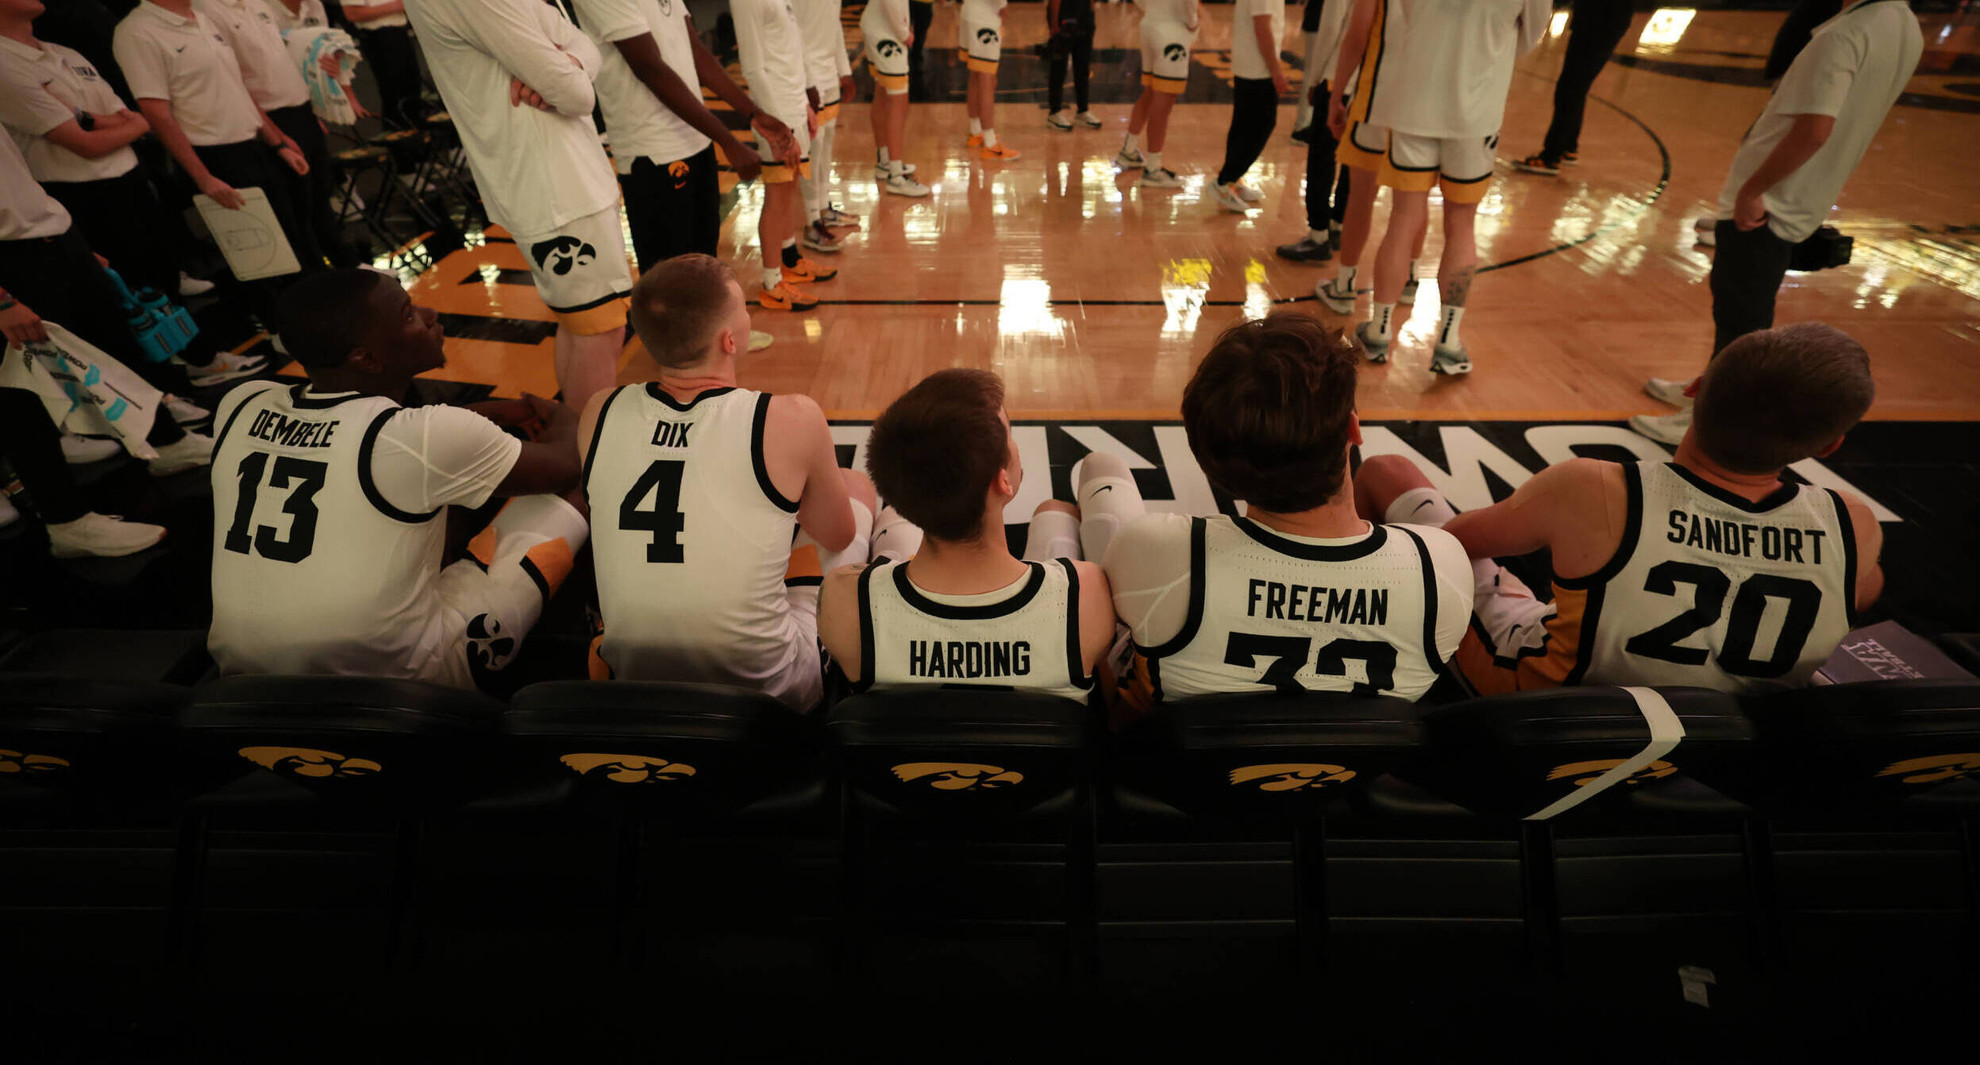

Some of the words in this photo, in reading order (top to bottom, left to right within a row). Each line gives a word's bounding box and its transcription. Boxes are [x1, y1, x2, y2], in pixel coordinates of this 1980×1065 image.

[249, 409, 340, 447] DEMBELE
[651, 420, 694, 448] DIX
[224, 451, 329, 563] 13
[619, 460, 685, 563] 4
[1667, 509, 1826, 565] SANDFORT
[1248, 578, 1388, 625] FREEMAN
[1625, 560, 1822, 678] 20
[910, 640, 1031, 678] HARDING
